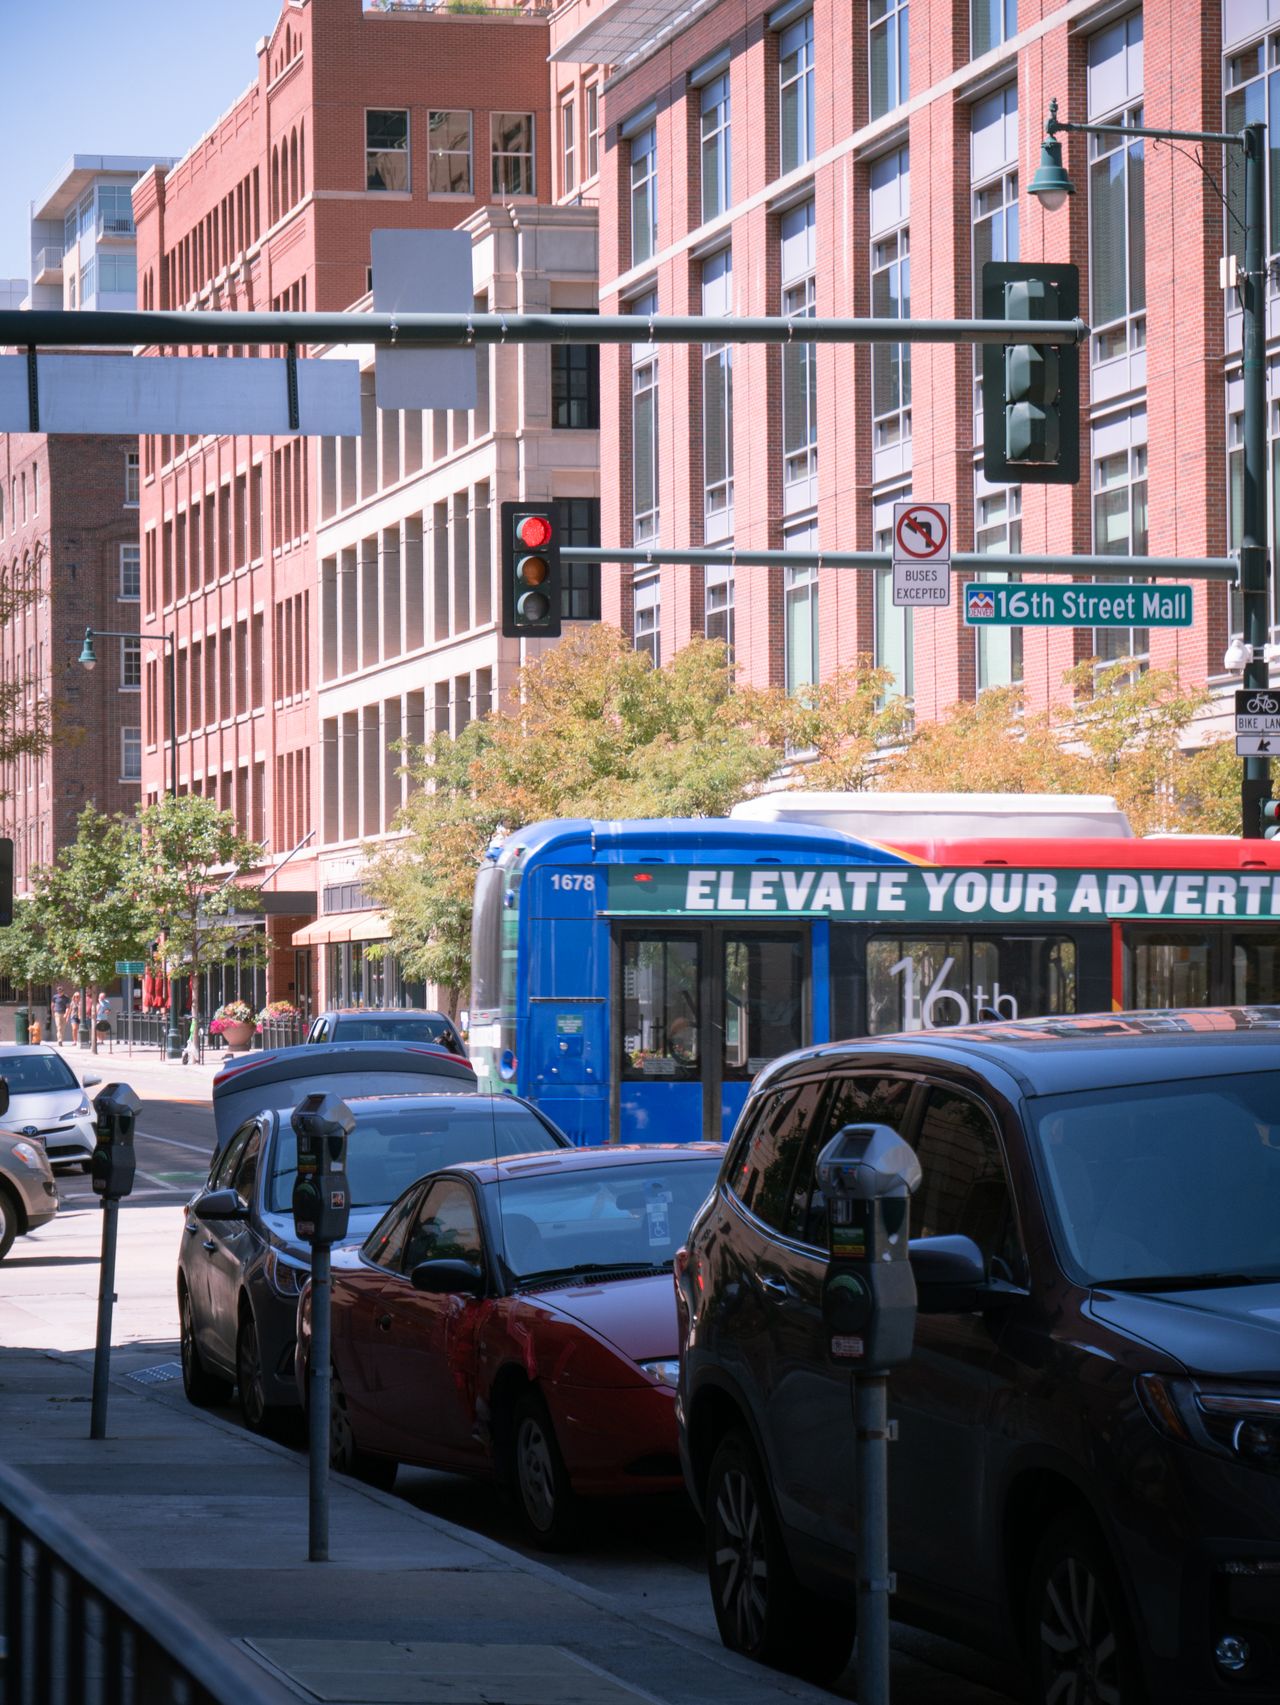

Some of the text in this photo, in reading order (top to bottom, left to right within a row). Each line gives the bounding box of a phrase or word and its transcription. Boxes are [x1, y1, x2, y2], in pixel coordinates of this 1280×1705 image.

[905, 570, 938, 581] BUSES
[896, 588, 946, 599] EXCEPTED
[968, 607, 994, 617] DENVER
[997, 591, 1186, 619] 16th Street Mall
[1238, 717, 1258, 729] BIKE
[550, 874, 595, 891] 1678
[685, 870, 908, 911] ELEVATE
[921, 872, 1057, 913] YOUR
[889, 956, 1018, 1031] 16th
